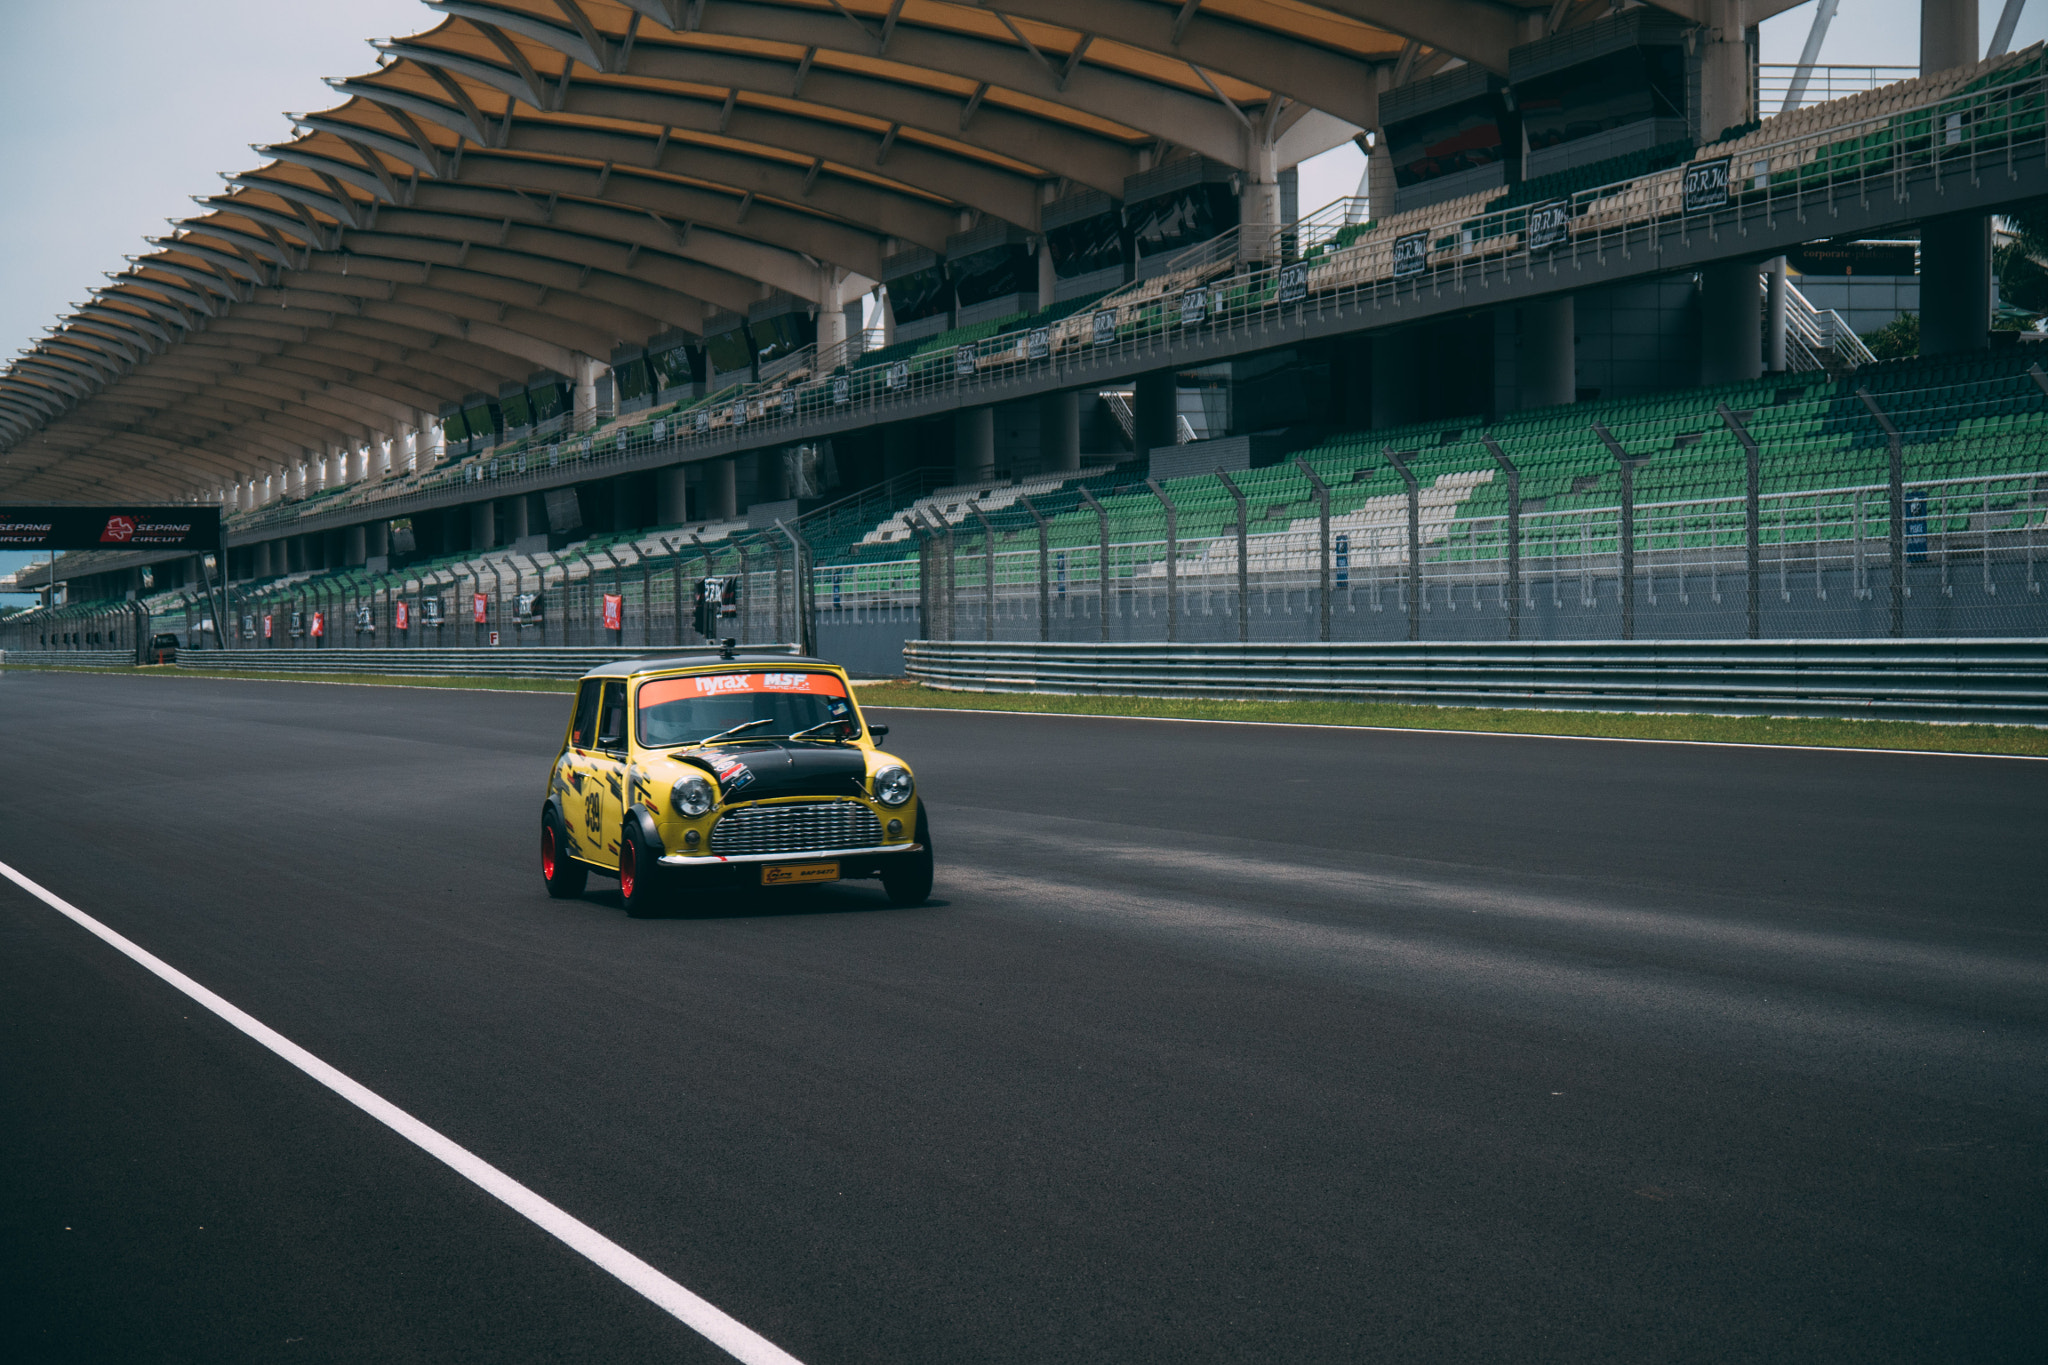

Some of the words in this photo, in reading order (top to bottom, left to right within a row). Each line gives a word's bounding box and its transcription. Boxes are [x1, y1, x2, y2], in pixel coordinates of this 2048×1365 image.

[1804, 250, 1849, 260] corporate
[490, 632, 498, 643] F
[764, 673, 807, 686] MSF
[585, 792, 600, 832] 339
